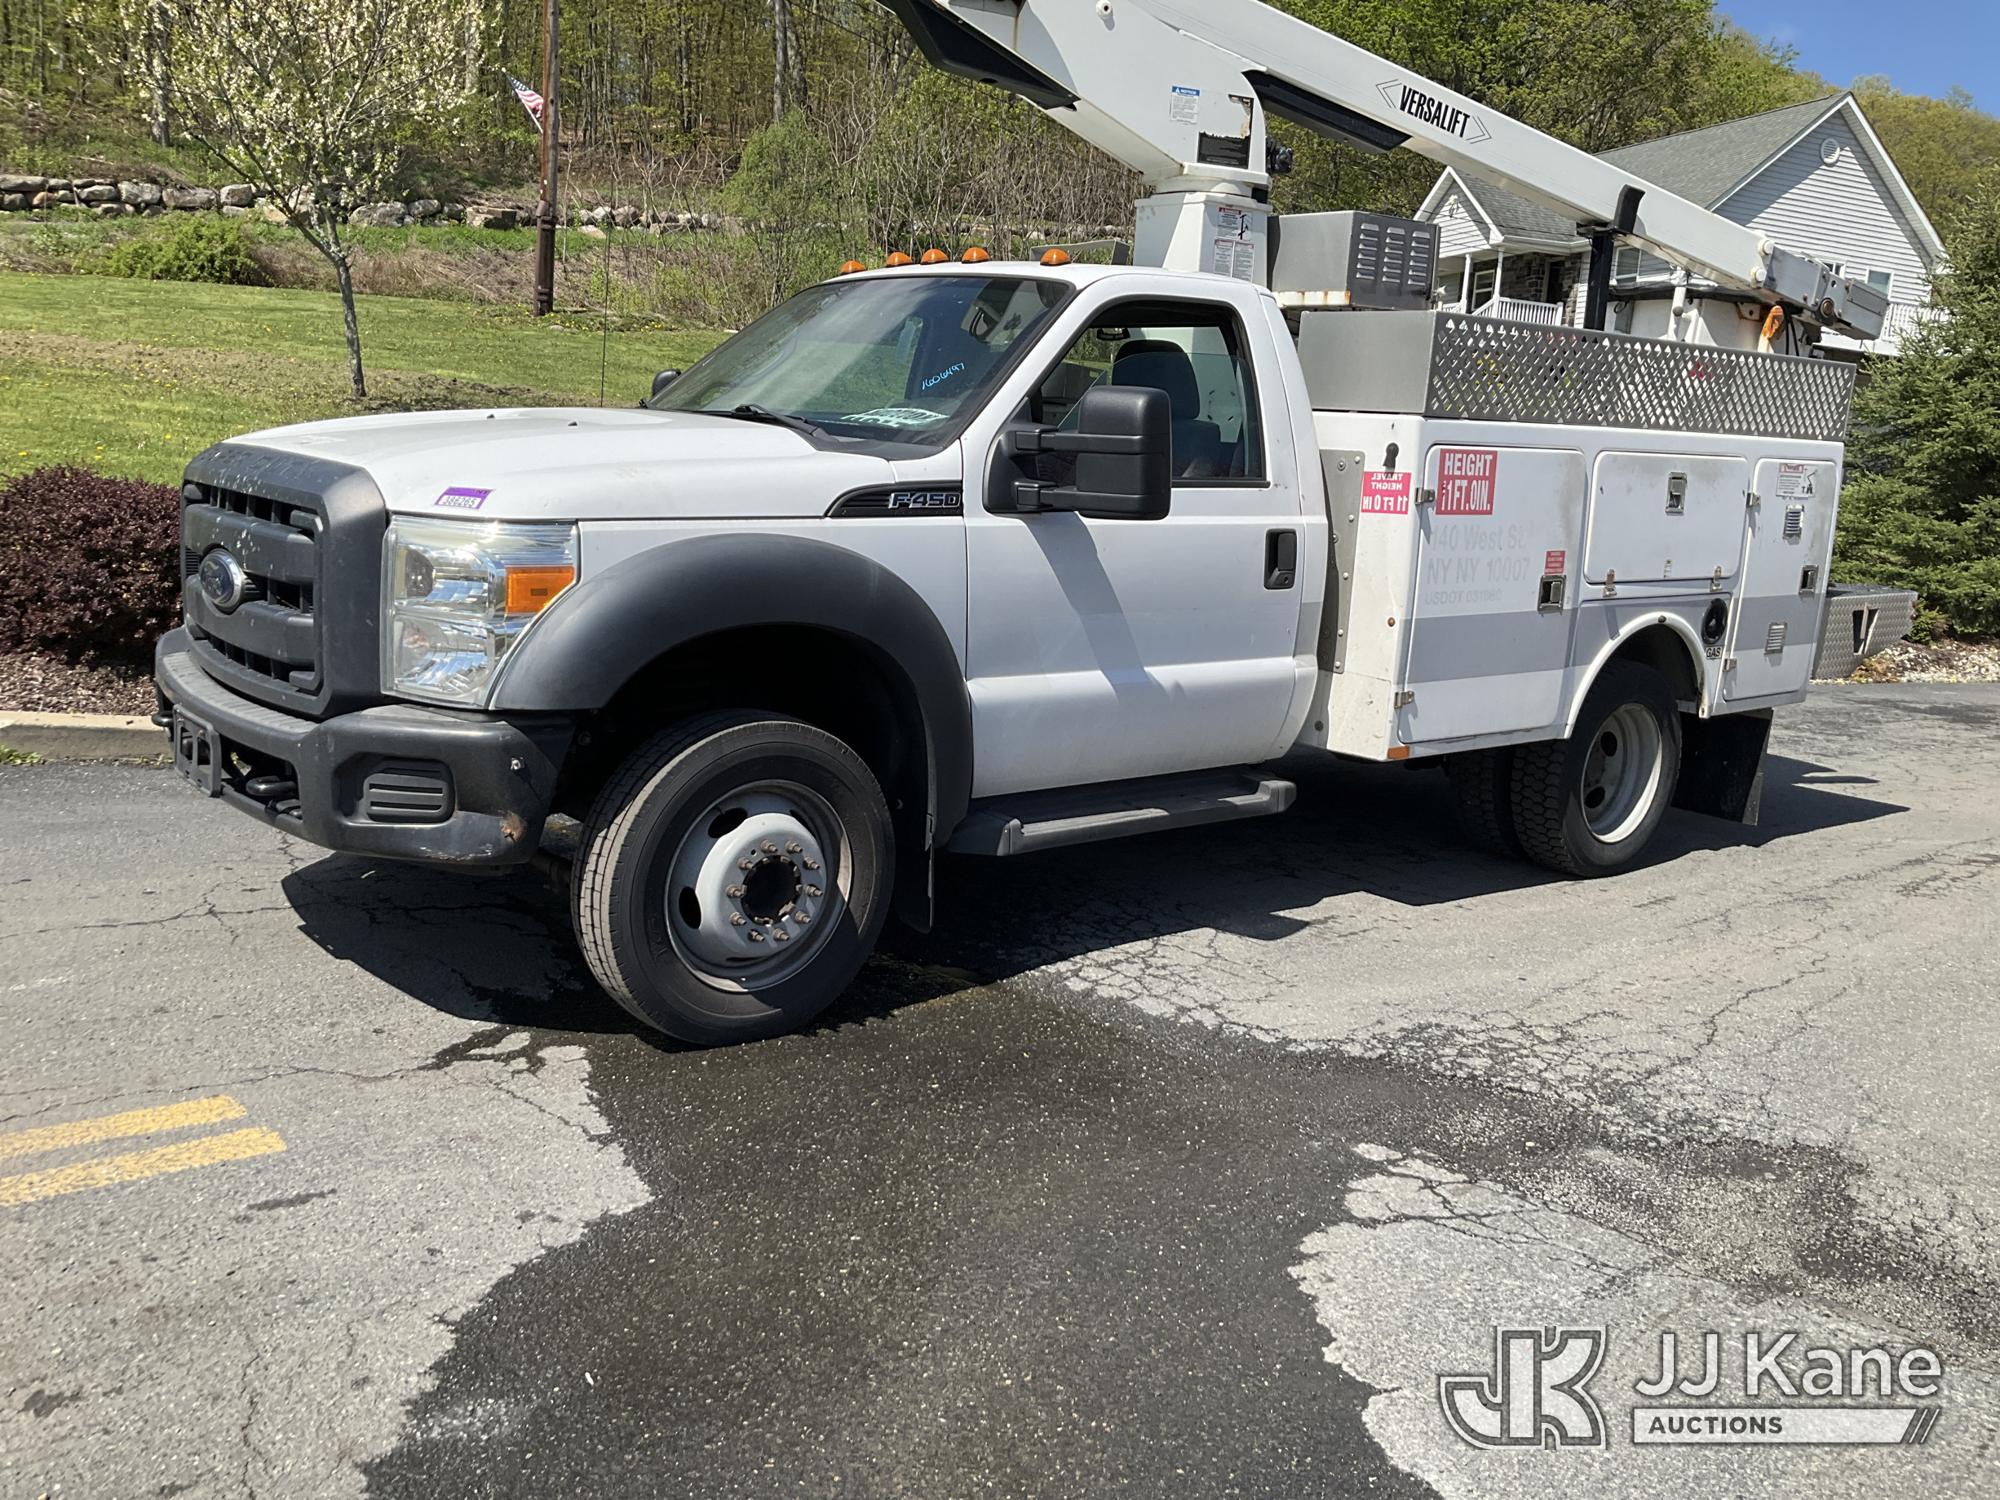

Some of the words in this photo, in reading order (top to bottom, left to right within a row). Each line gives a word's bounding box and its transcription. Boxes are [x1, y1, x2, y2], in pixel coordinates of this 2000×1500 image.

[1399, 85, 1471, 138] VERSALIFT
[1444, 453, 1493, 476] HEIGHT
[1426, 557, 1452, 585] NY
[1456, 556, 1480, 584] NY
[1706, 647, 1721, 658] GAS
